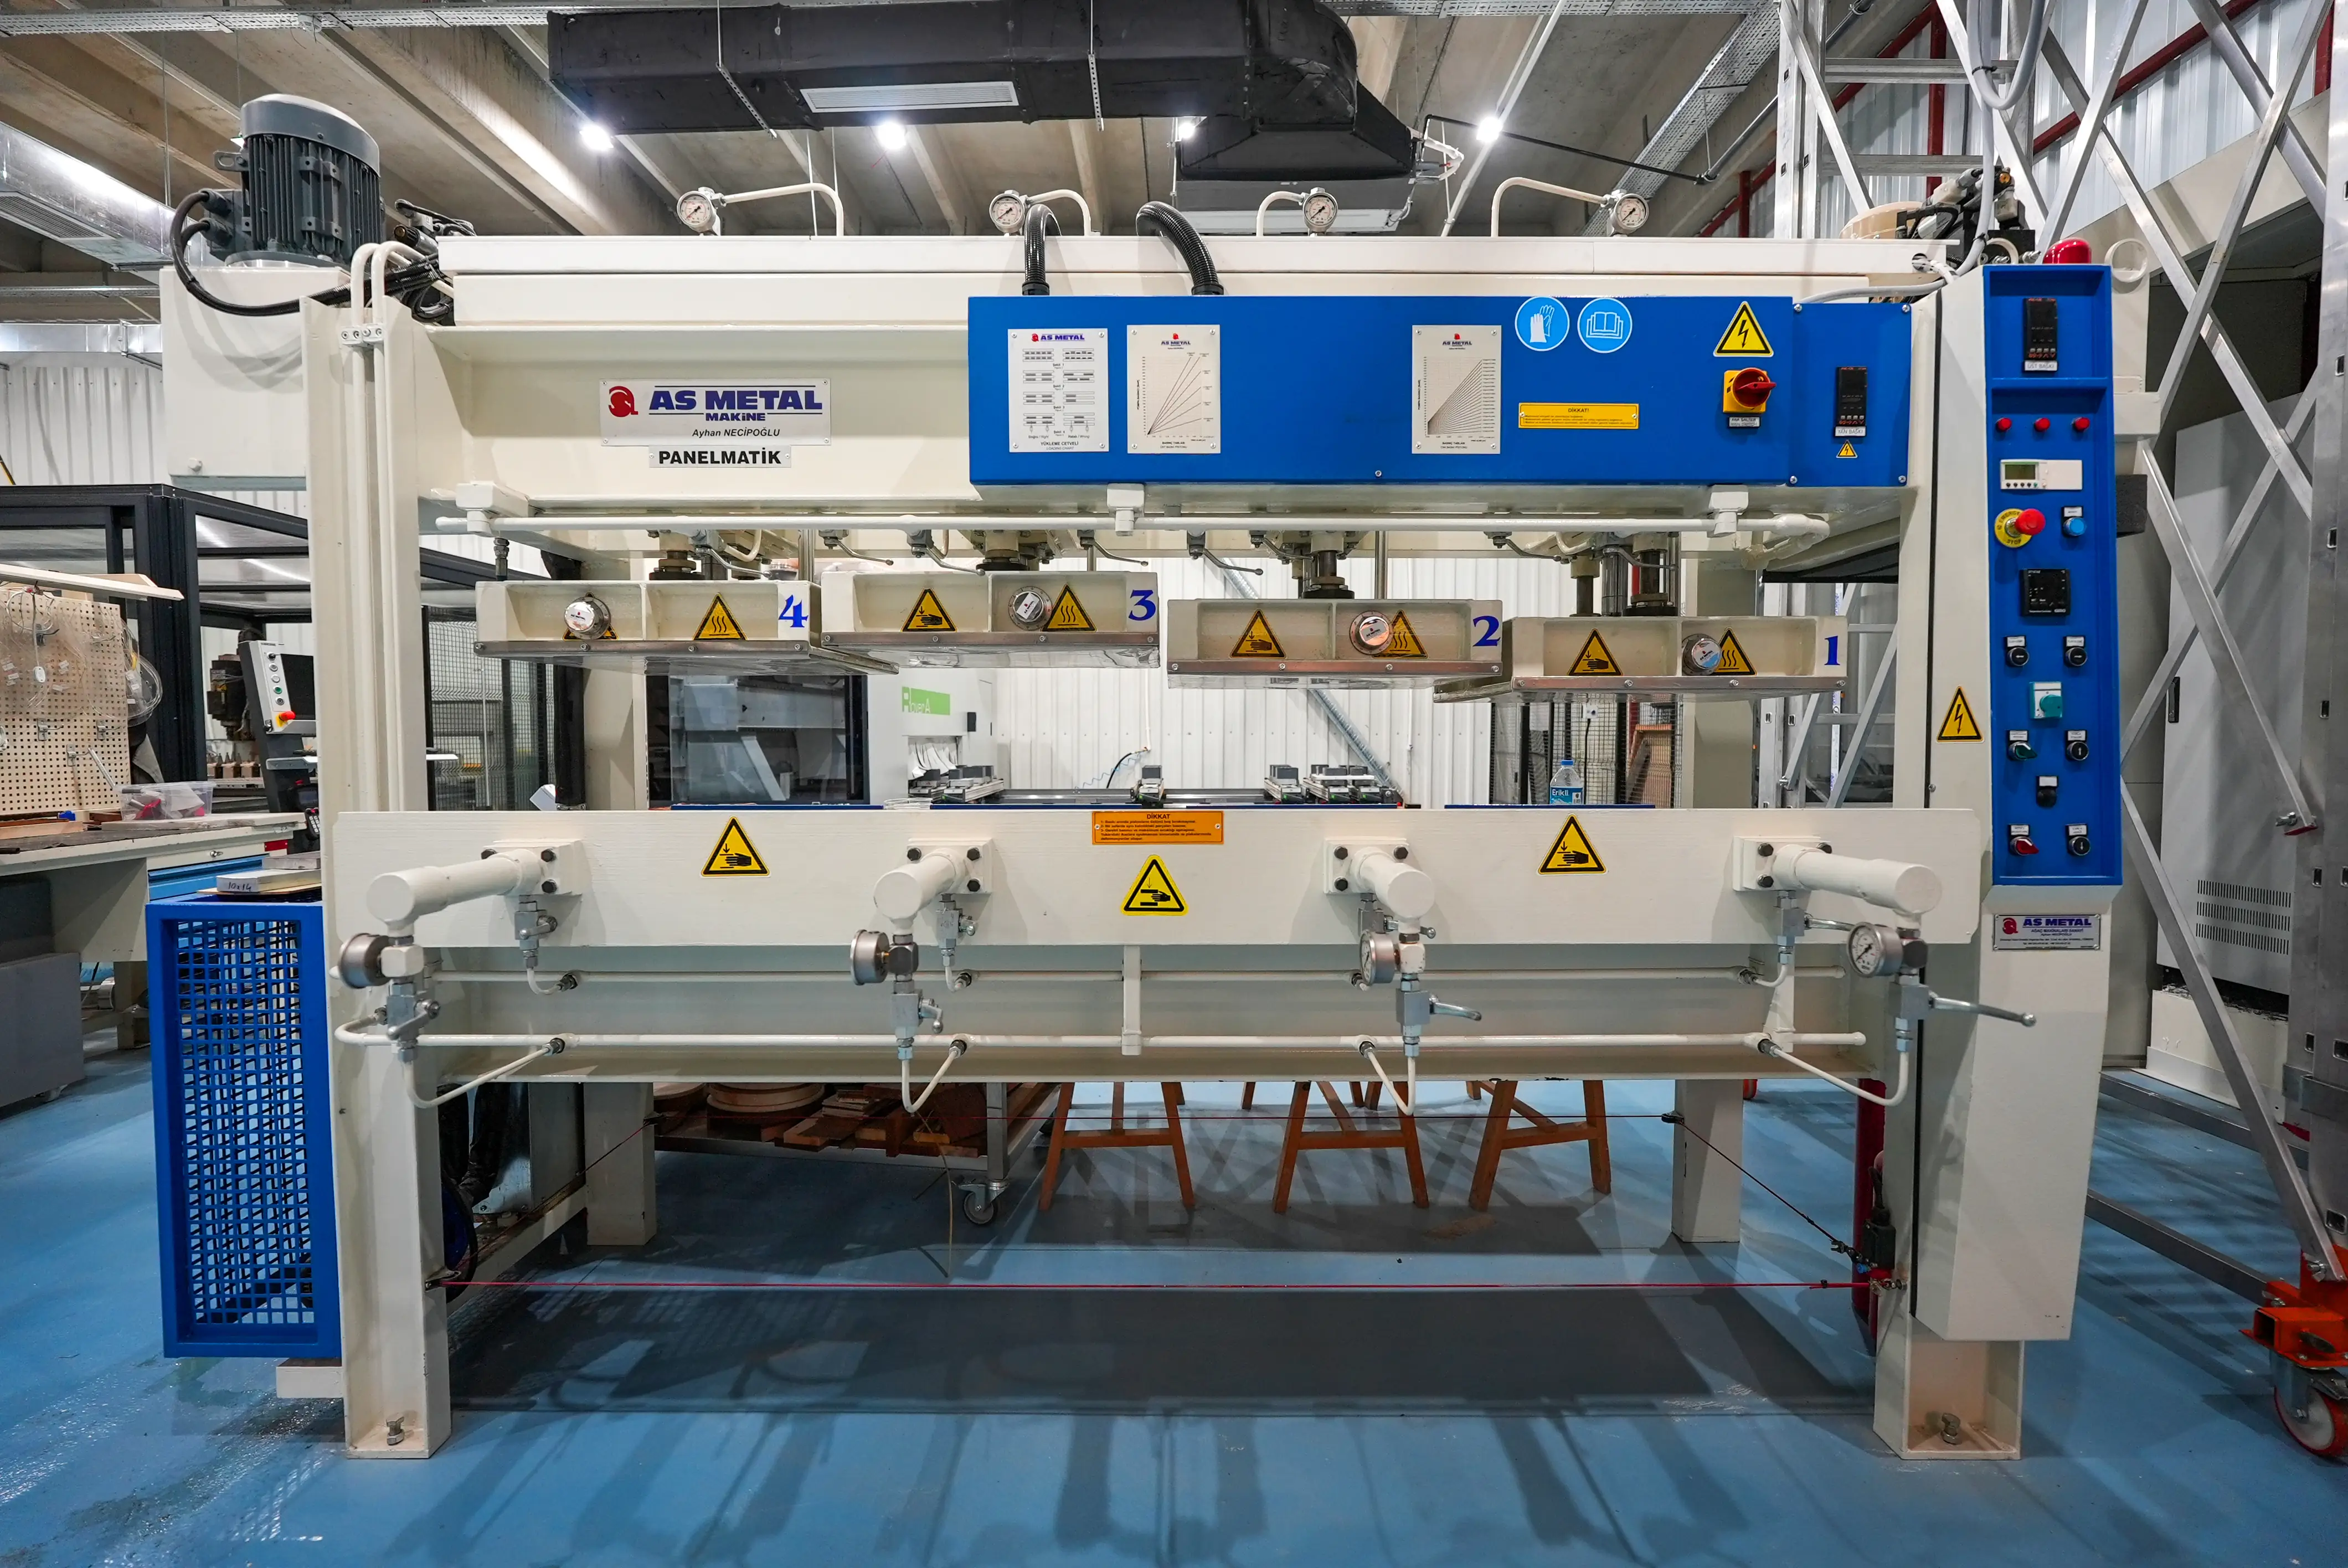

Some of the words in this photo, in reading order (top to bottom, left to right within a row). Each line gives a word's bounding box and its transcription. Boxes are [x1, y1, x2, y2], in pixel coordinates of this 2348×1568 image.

[649, 390, 696, 410] AS
[705, 390, 823, 410] METAL
[692, 429, 721, 439] Ayhan
[724, 426, 780, 437] NECİPOĞLU
[659, 447, 782, 465] PANELMATİK
[778, 594, 809, 628] 4
[1128, 590, 1156, 621] 3
[1472, 615, 1501, 647] 2
[1824, 635, 1841, 666] 1
[2023, 918, 2042, 926] AS
[2045, 918, 2092, 926] METAL
